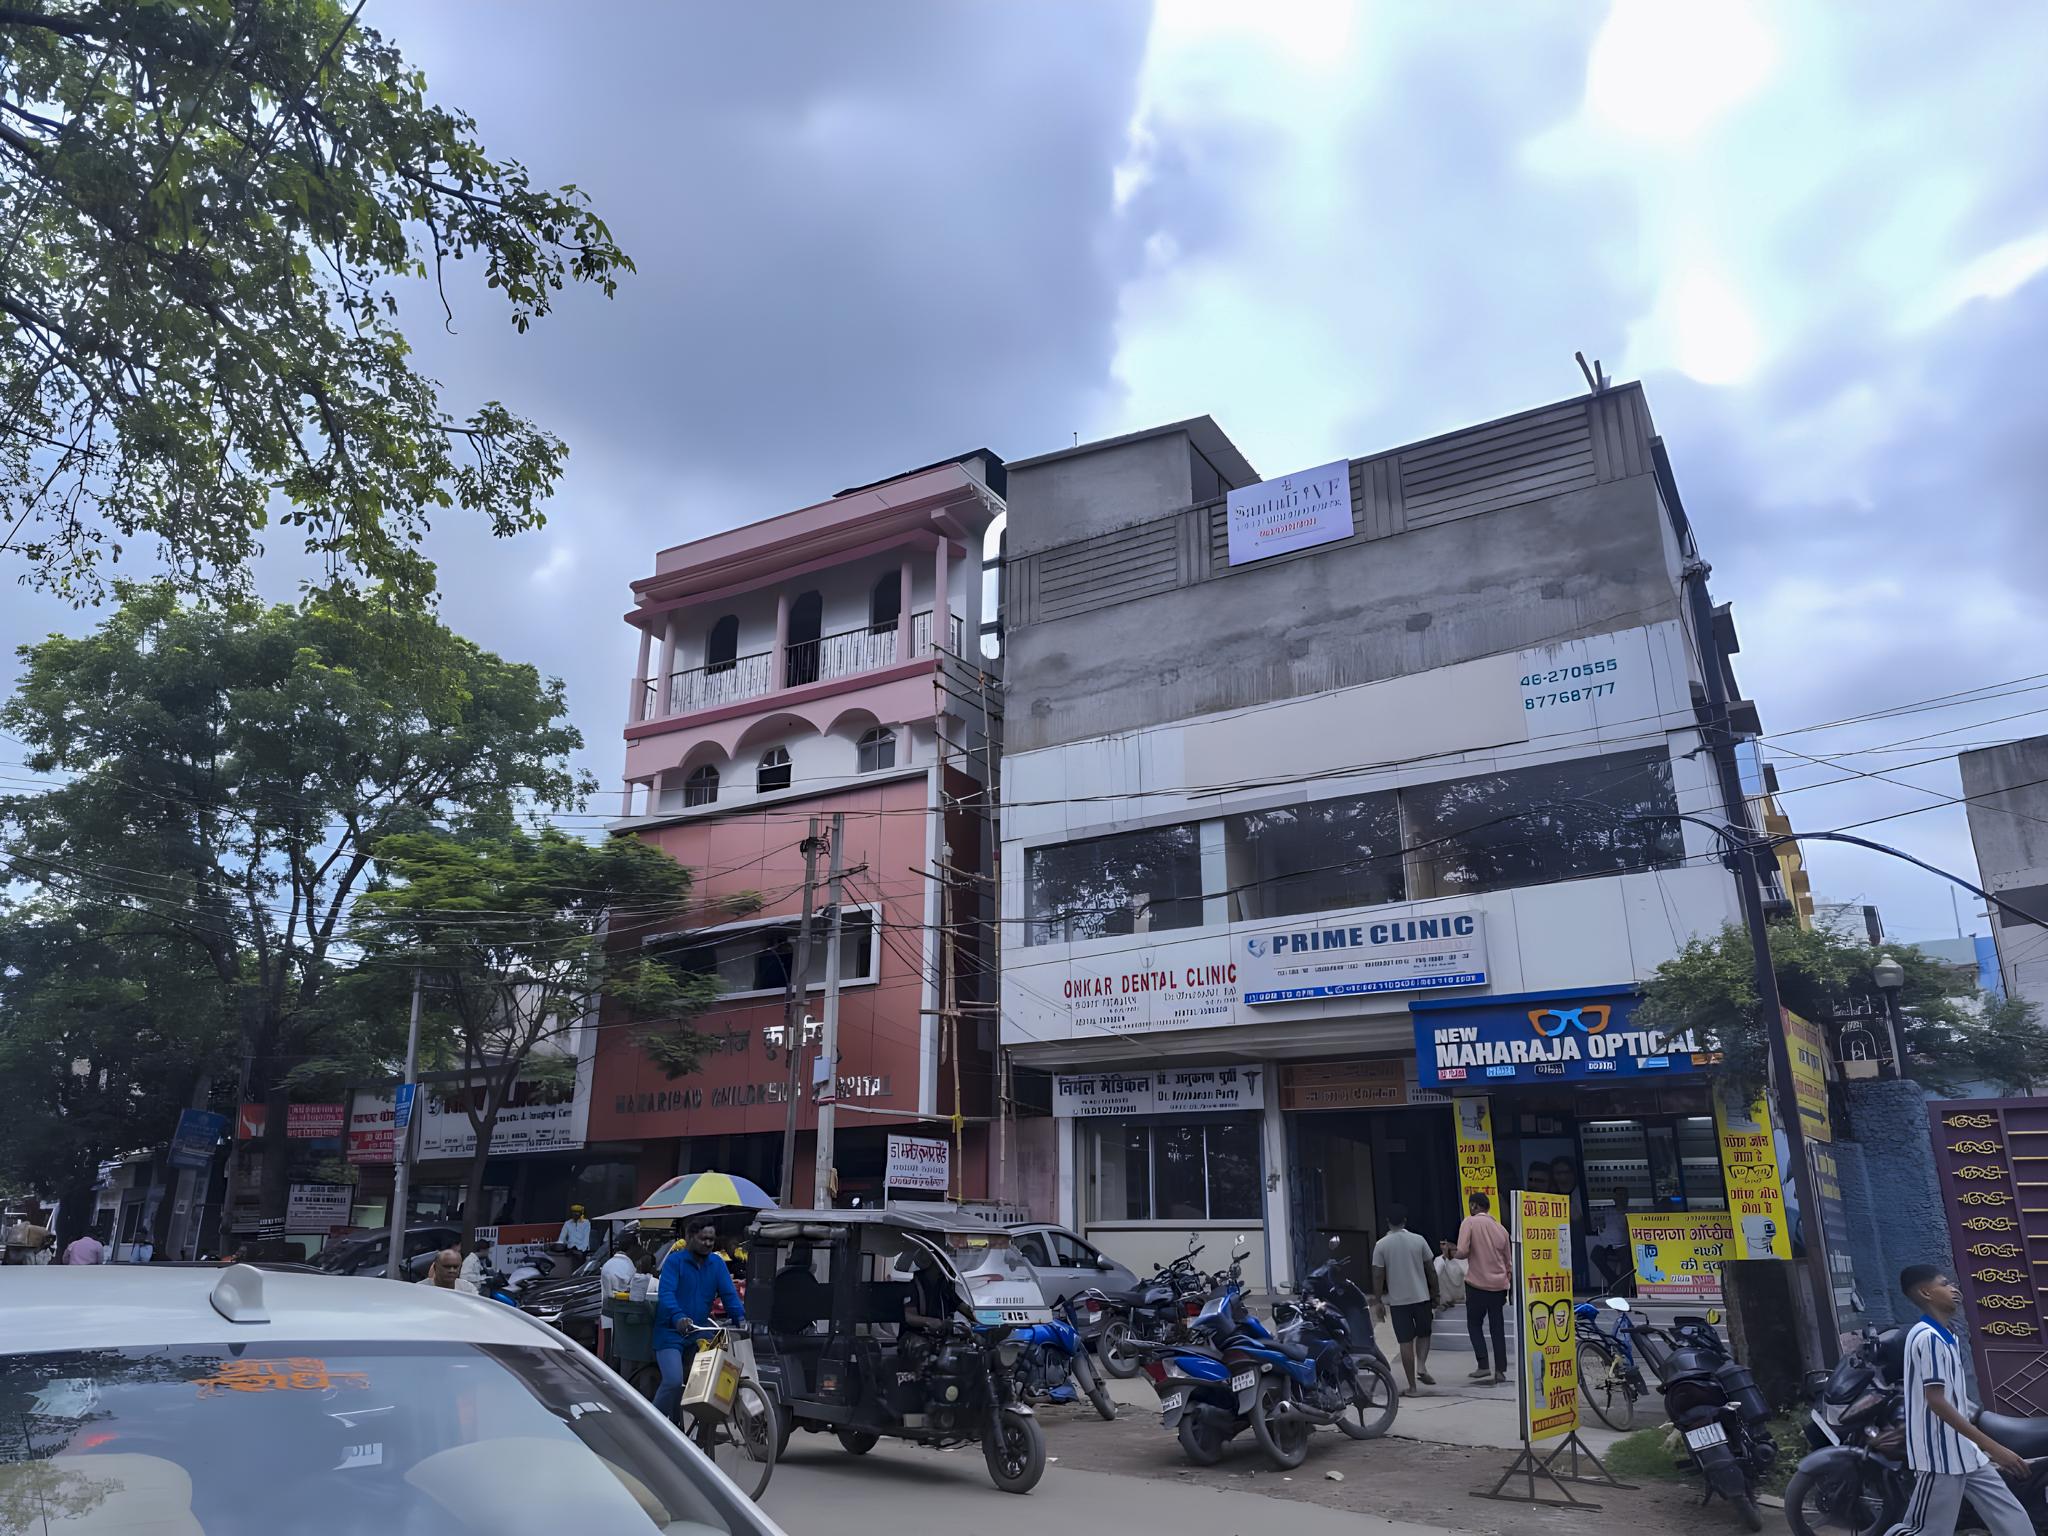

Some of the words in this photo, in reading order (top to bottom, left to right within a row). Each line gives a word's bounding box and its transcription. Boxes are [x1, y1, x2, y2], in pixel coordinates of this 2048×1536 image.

[1272, 925, 1363, 955] PRIME
[1370, 915, 1474, 944] CLINIC
[1064, 977, 1112, 999] ONKAR
[1122, 970, 1177, 994] DENTAL
[1186, 963, 1237, 988] CLINIC
[1434, 1027, 1477, 1044] NEW
[1435, 1036, 1581, 1067] MAHARAJA
